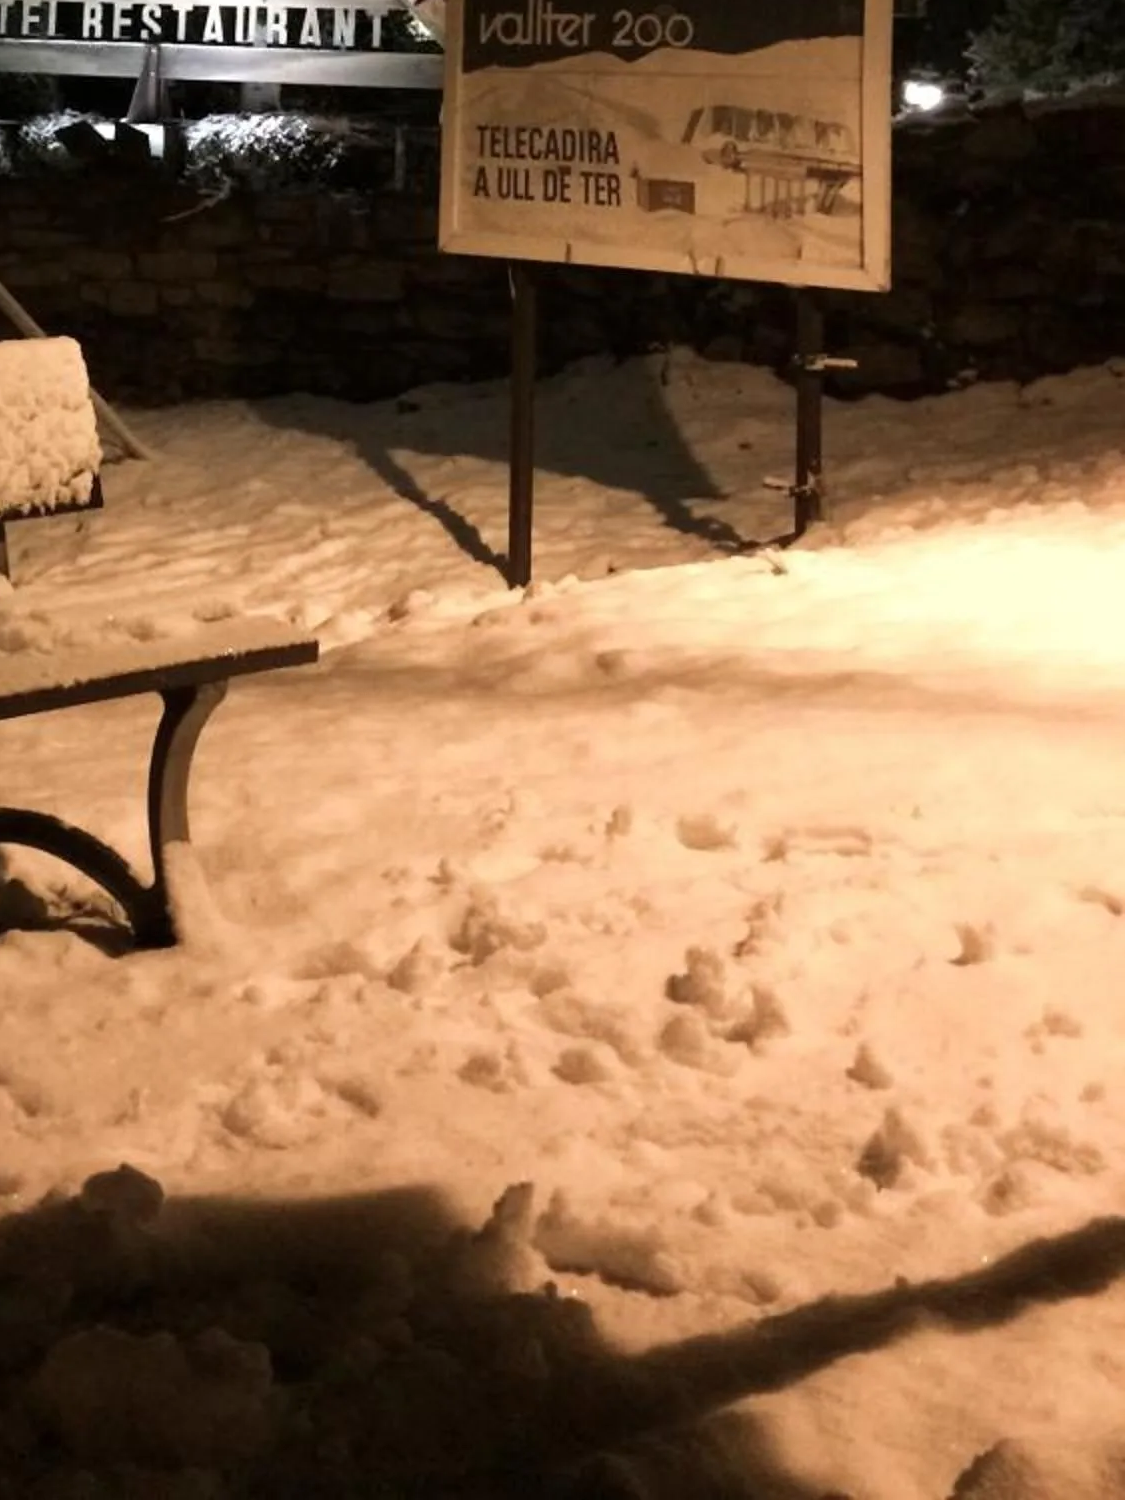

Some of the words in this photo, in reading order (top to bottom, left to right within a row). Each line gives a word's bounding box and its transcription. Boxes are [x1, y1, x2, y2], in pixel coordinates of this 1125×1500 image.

[81, 2, 387, 50] RESTAURANT
[477, 125, 620, 165] TELECADIRA
[474, 167, 491, 198] A
[497, 168, 536, 201] ULL
[543, 170, 572, 204] DE
[581, 171, 622, 207] TER
